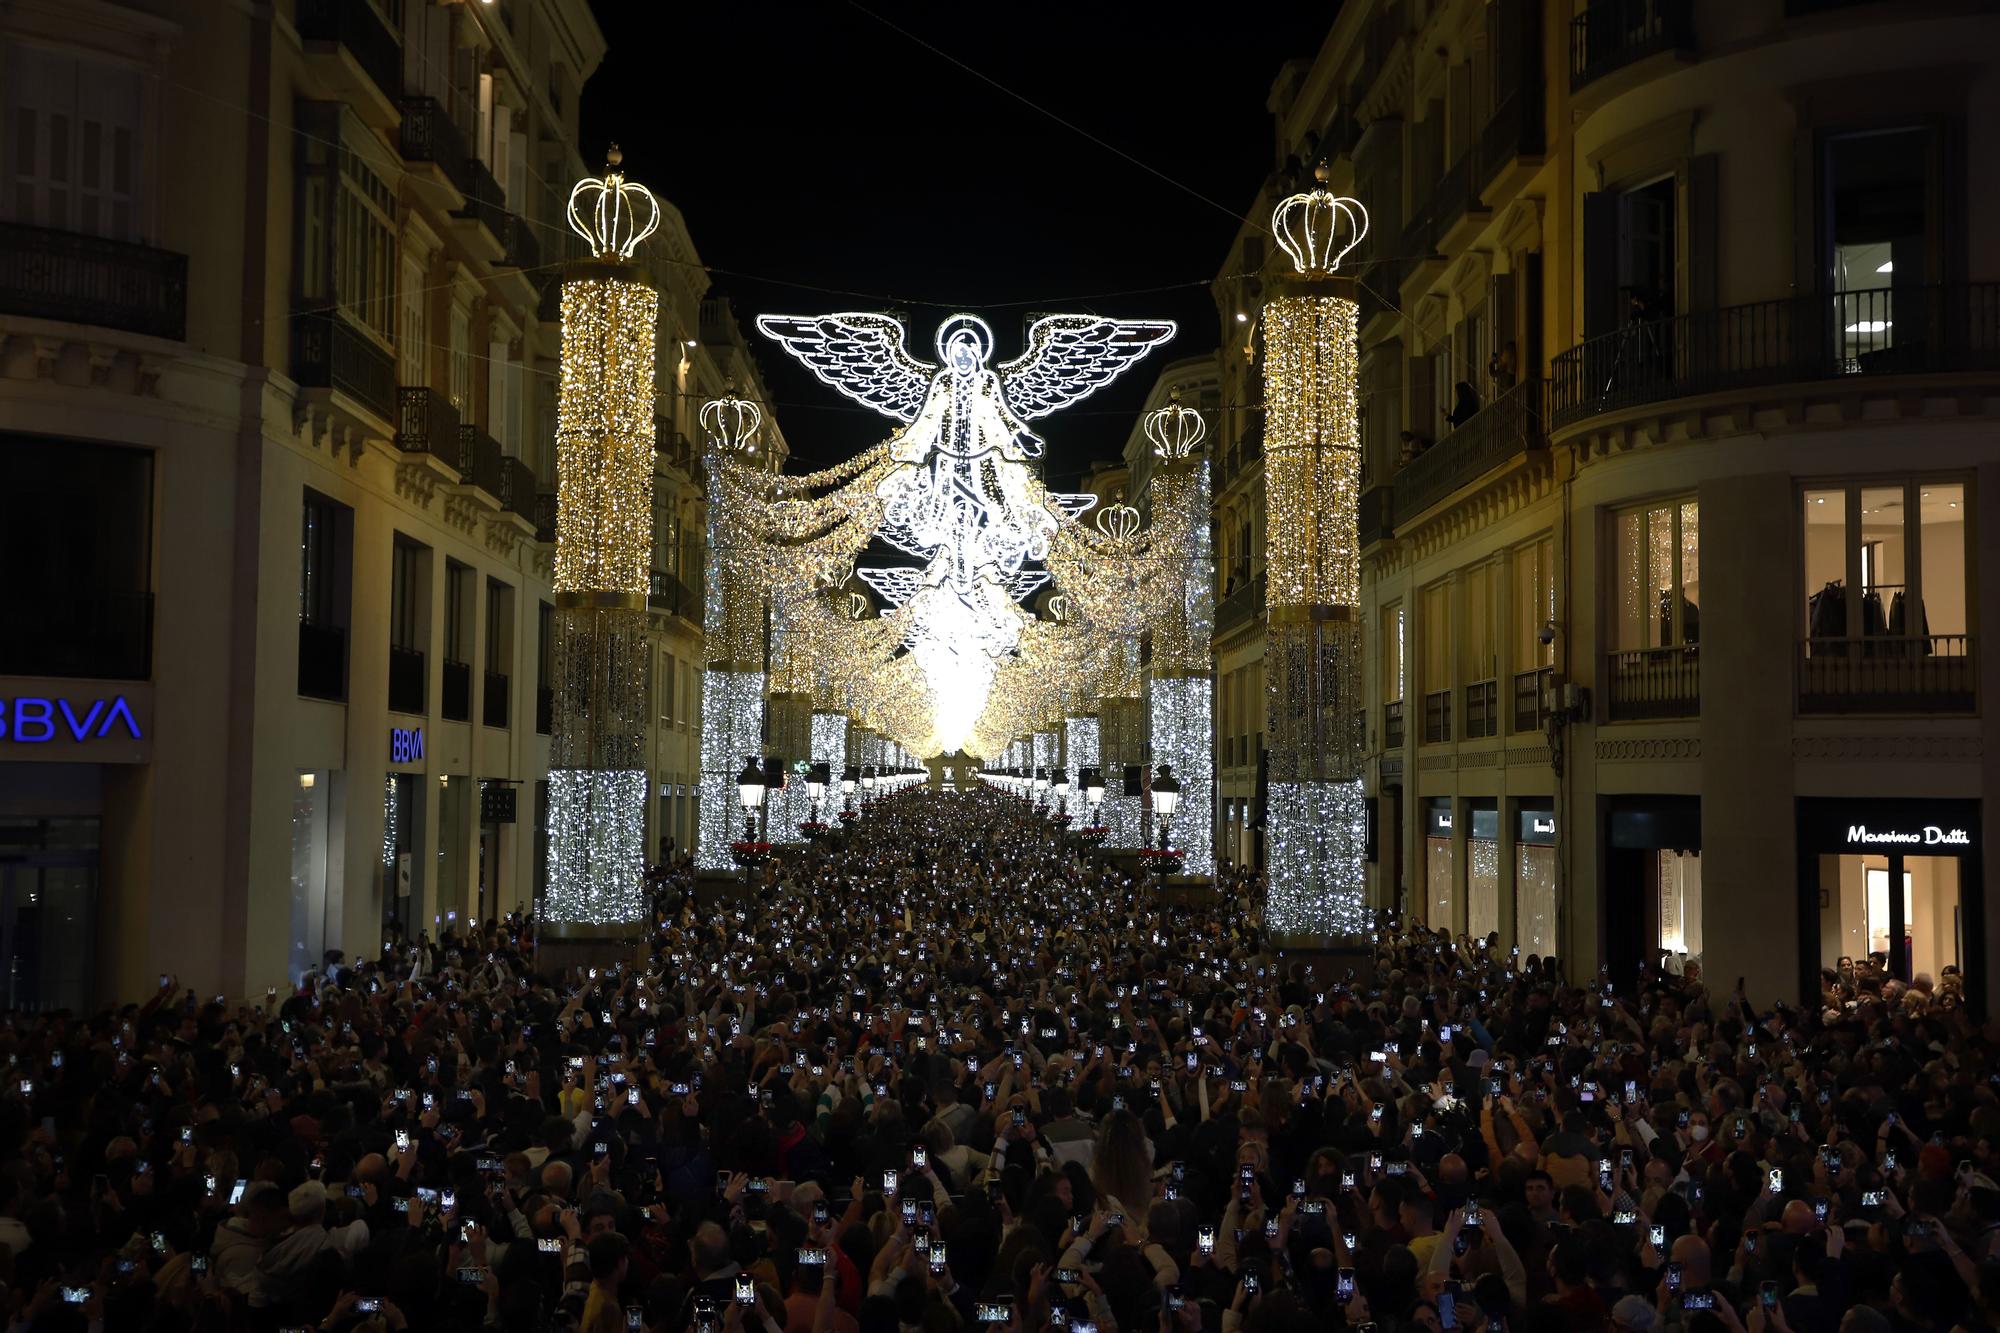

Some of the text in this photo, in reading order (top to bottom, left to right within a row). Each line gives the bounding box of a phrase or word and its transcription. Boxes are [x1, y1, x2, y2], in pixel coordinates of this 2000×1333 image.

[0, 695, 143, 743] BVA
[391, 728, 424, 763] BBVA
[1847, 825, 1970, 845] Massimo Dutti
